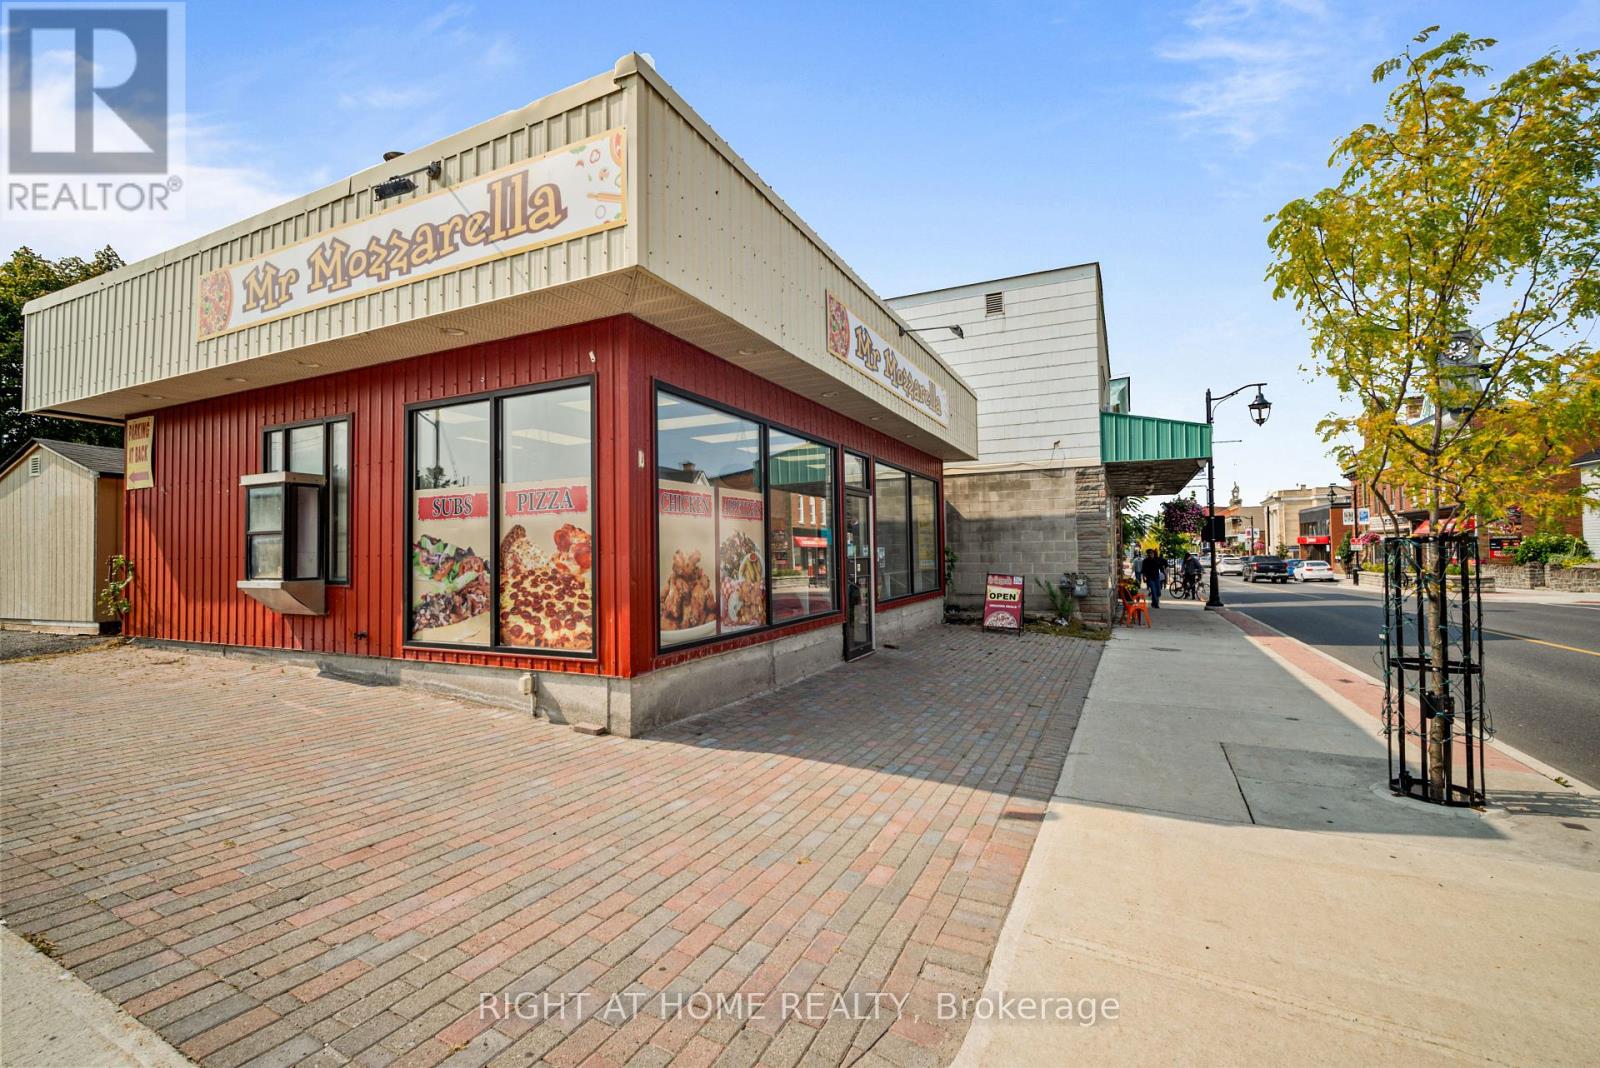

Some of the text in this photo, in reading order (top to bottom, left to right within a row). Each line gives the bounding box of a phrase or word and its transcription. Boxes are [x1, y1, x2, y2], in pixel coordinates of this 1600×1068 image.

[242, 169, 568, 314] Mr Mozzarella
[854, 325, 881, 372] Mr
[128, 421, 150, 441] PARKING
[432, 495, 473, 517] SUBS
[516, 488, 573, 513] PIZZA
[661, 492, 709, 515] CHICKEN
[989, 593, 1016, 601] OPEN
